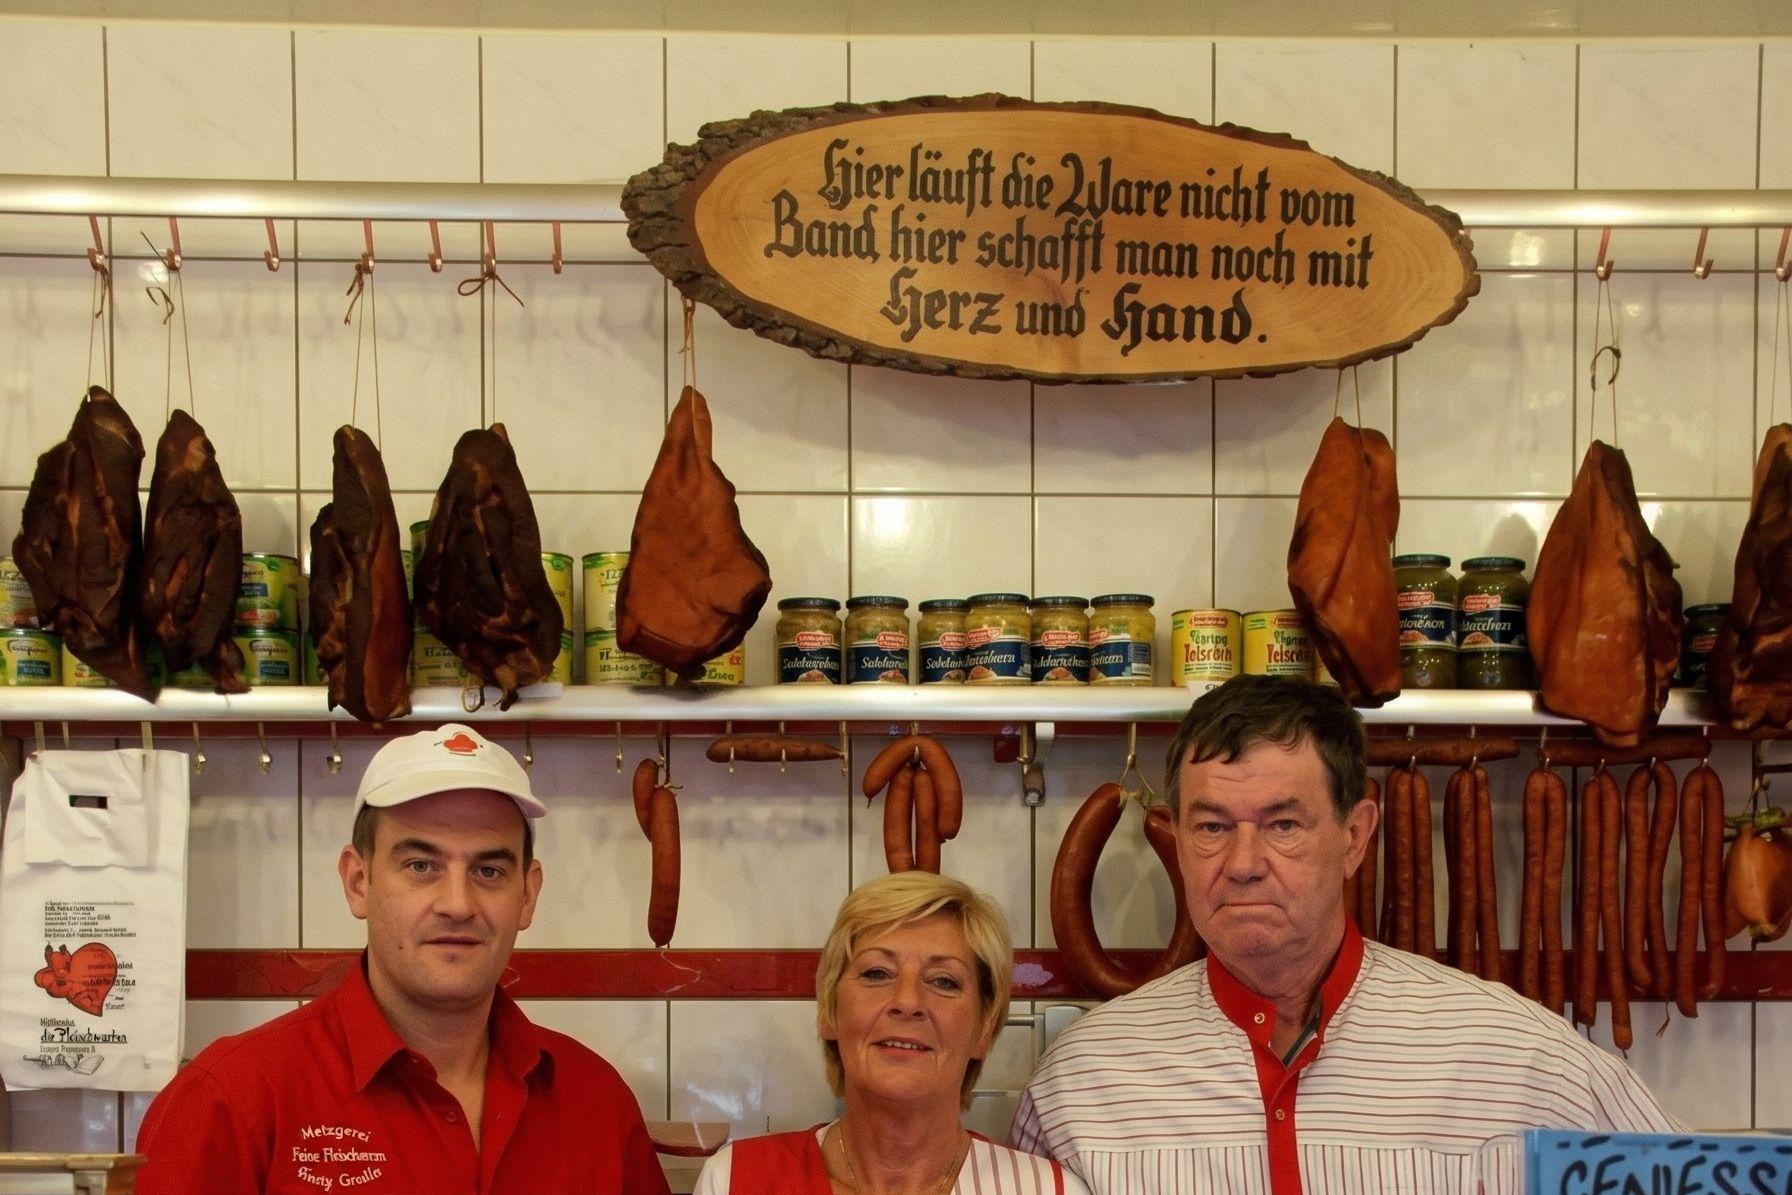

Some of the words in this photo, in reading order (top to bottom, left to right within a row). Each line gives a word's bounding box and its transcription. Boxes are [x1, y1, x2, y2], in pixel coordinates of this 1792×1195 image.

[817, 138, 904, 211] Hier
[908, 142, 995, 218] läuft
[1002, 152, 1054, 210] die
[1055, 152, 1172, 220] Ware
[1180, 164, 1271, 227] nicht
[1280, 187, 1356, 228] vom
[889, 203, 966, 265] hier
[976, 215, 1105, 285] schafft
[1115, 239, 1199, 279] man
[1211, 229, 1295, 288] noch
[1308, 233, 1374, 290] mit
[880, 266, 1005, 343] Herz
[1015, 287, 1086, 338] und
[1100, 282, 1268, 357] Hand.
[301, 1124, 372, 1143] Metzgerei
